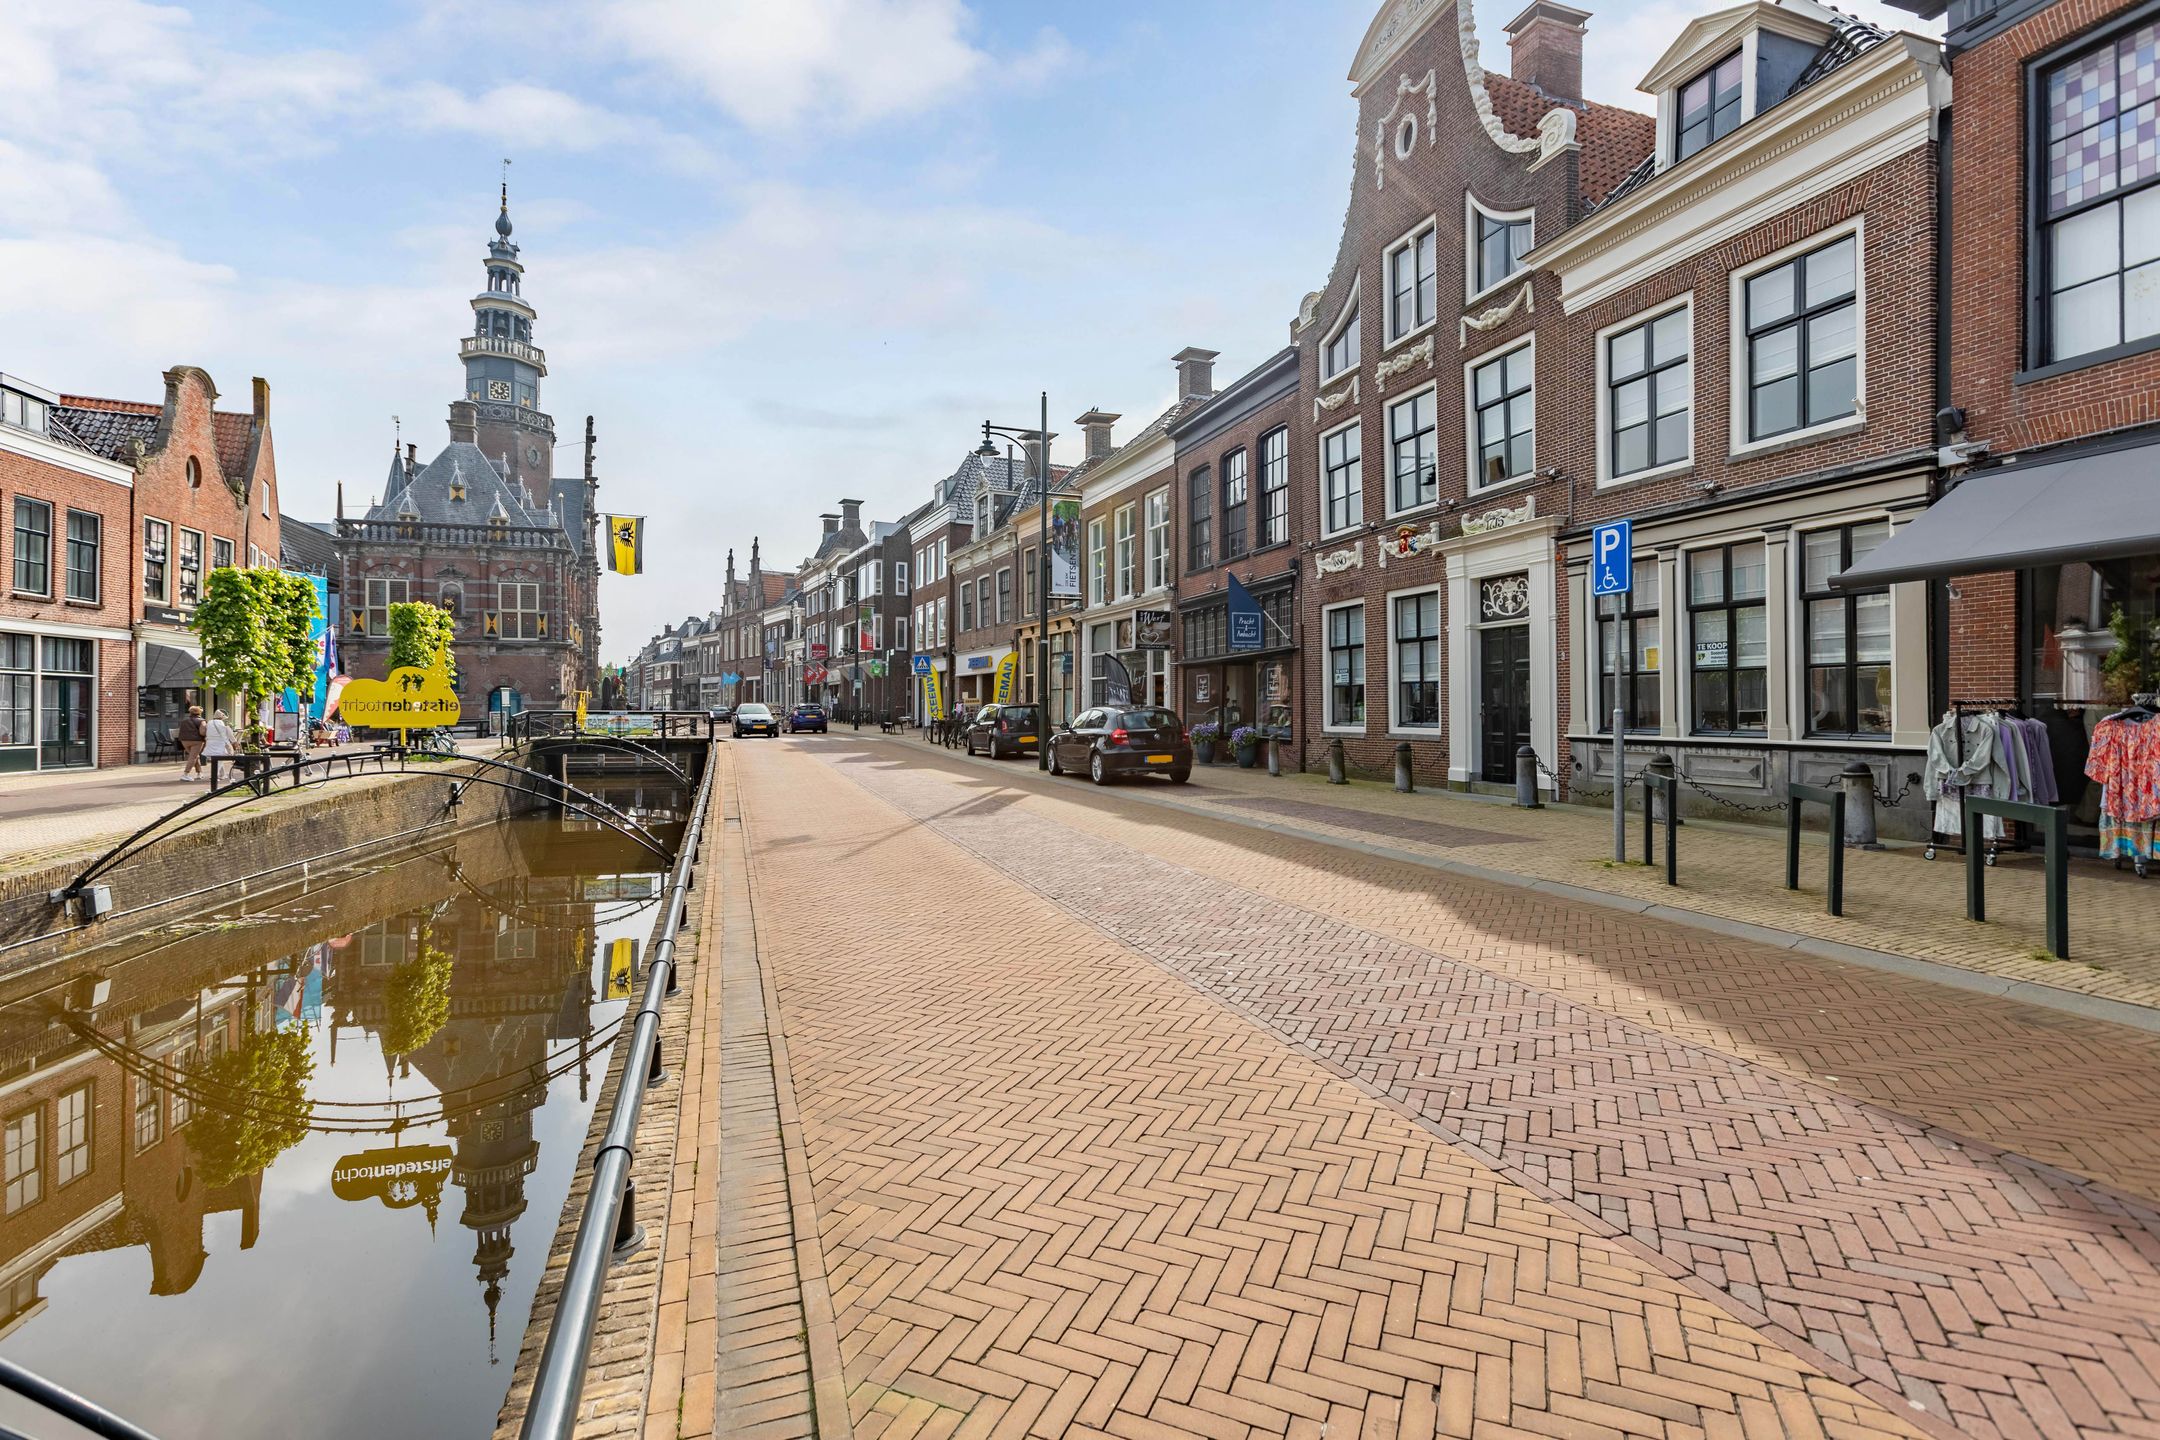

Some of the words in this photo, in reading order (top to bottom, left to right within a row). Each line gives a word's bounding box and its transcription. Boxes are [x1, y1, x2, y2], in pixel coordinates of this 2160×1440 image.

[1601, 528, 1620, 565] P
[1069, 554, 1077, 588] FIETSEN
[1238, 616, 1255, 625] Pracht
[1697, 643, 1706, 651] TE
[1706, 641, 1728, 650] KOOP
